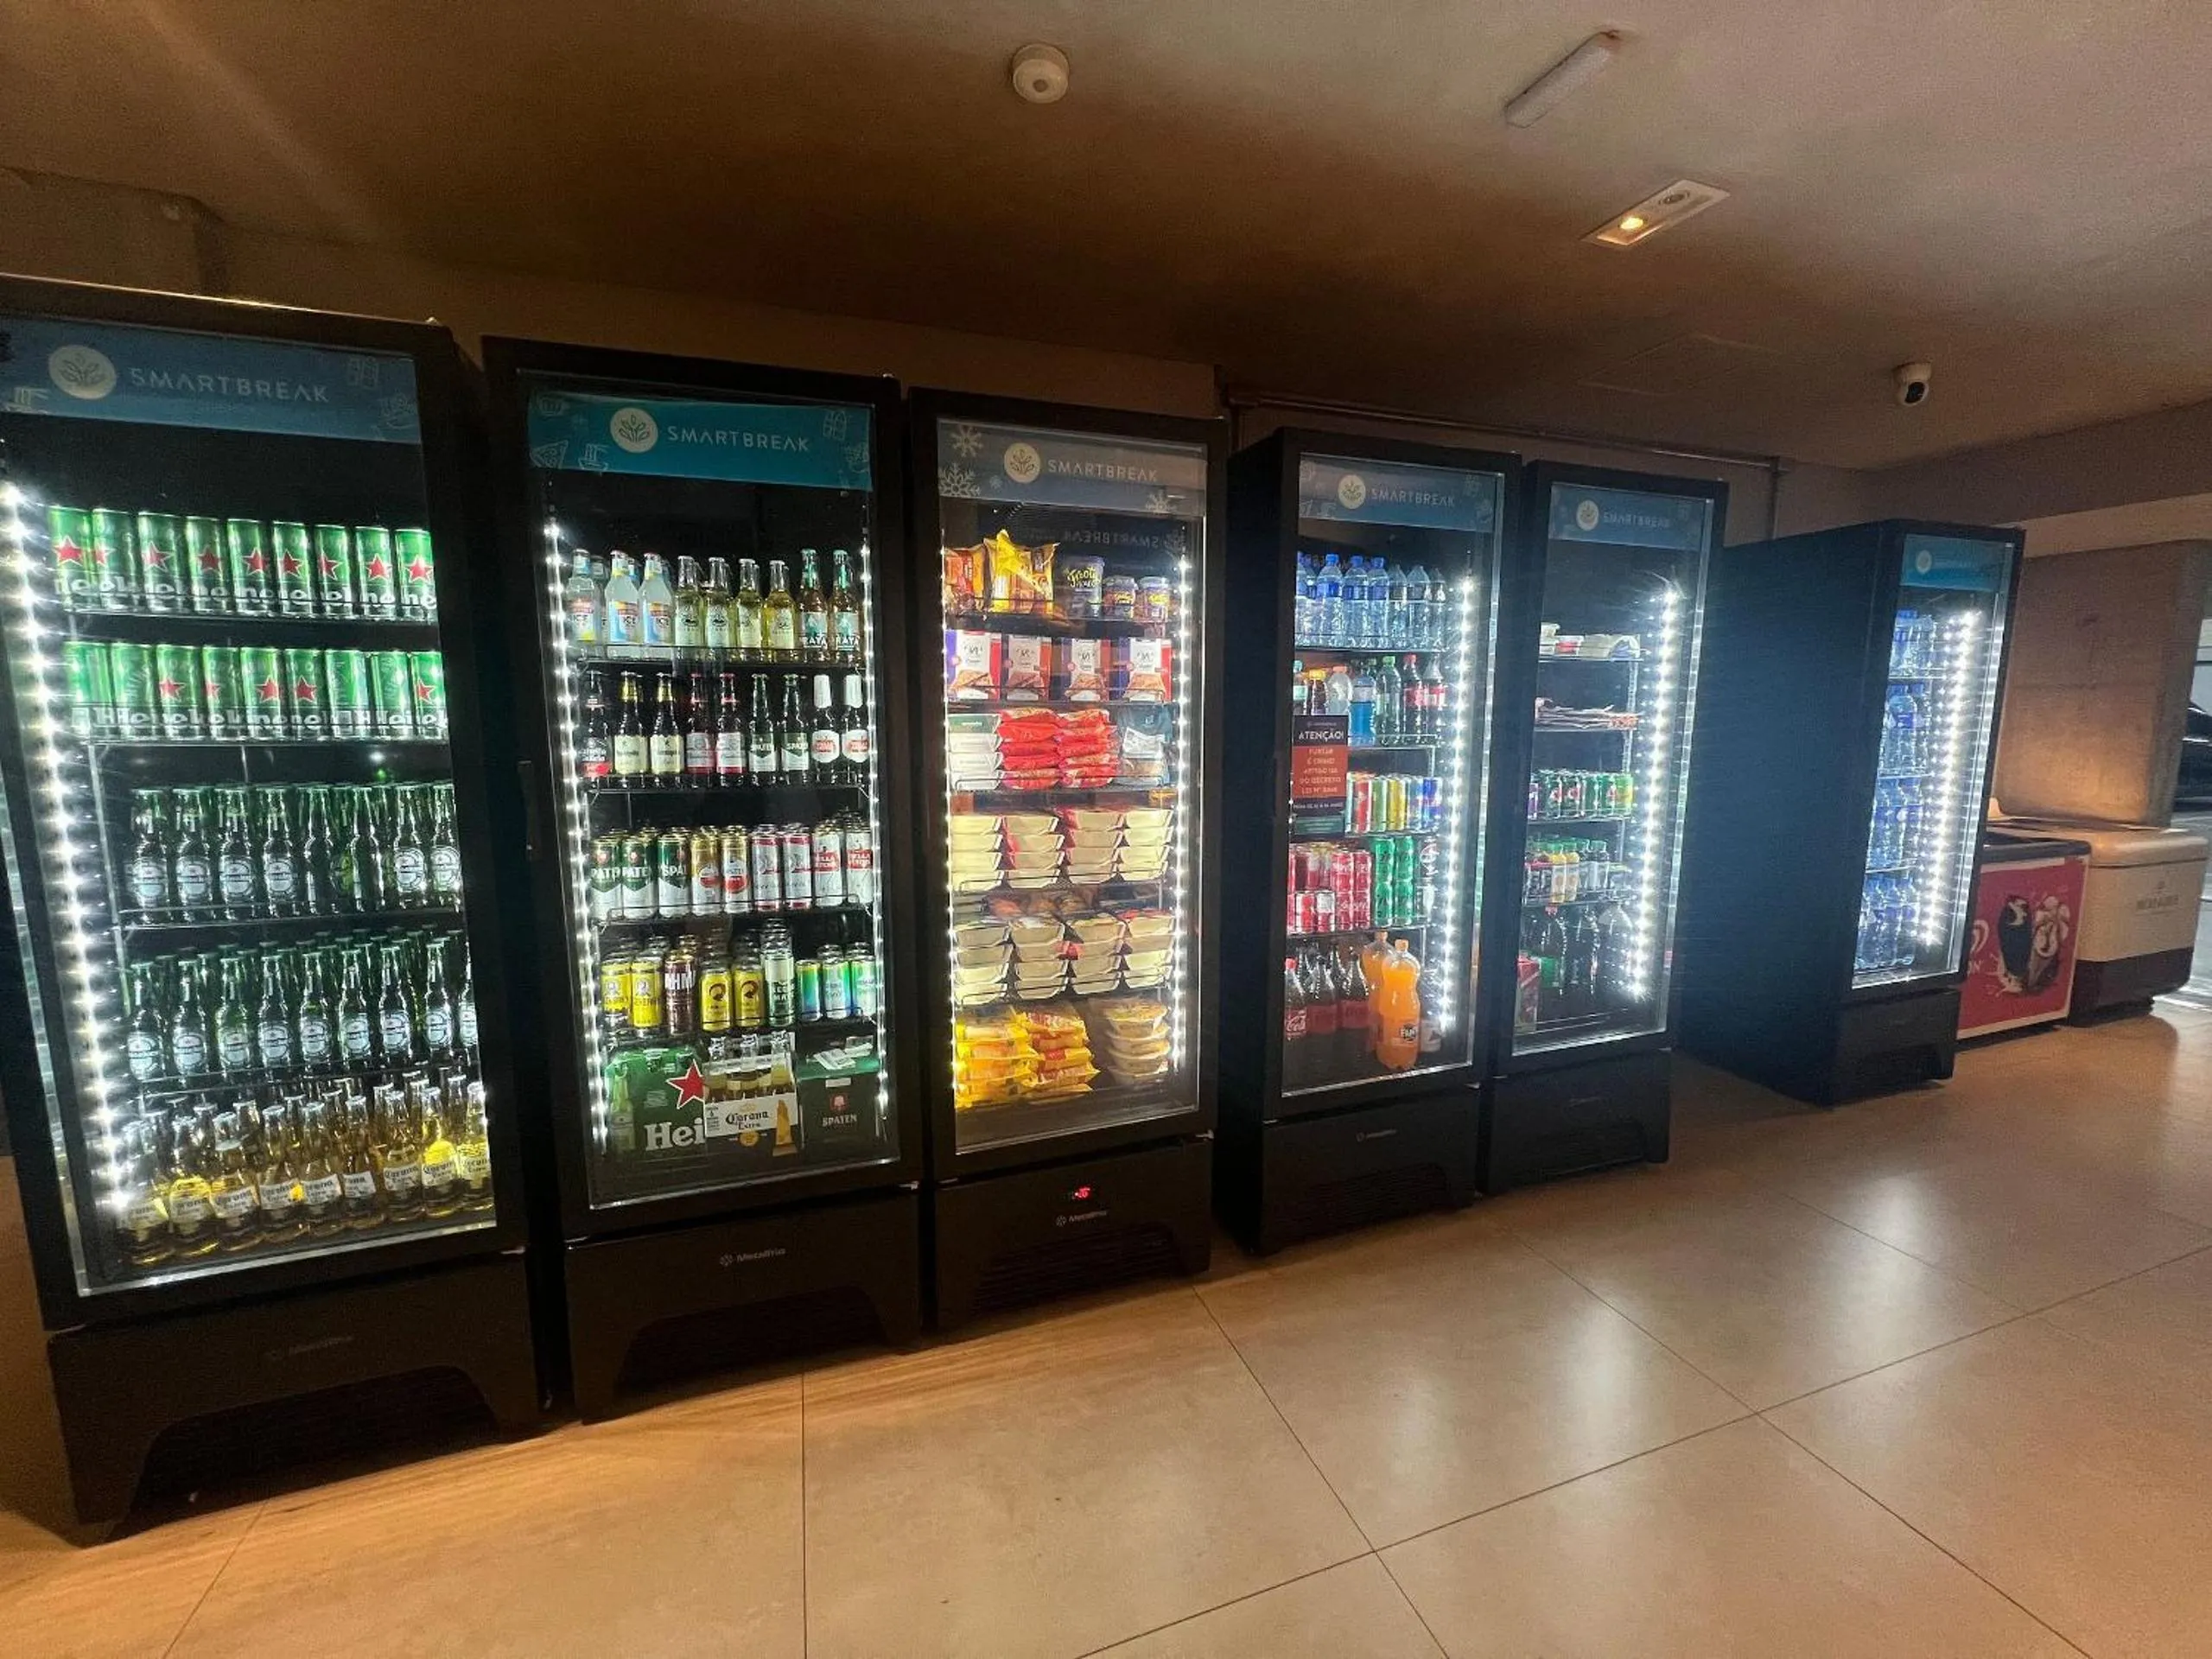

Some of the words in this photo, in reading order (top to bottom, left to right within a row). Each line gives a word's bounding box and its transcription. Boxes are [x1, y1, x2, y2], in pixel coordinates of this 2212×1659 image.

[129, 366, 331, 404] SMARTBREAK
[666, 424, 810, 453] SMARTBREAK
[1047, 458, 1159, 484] SMARTBREAK
[1370, 487, 1456, 509] SMARTBREAK
[1298, 728, 1344, 742] ATENÇÃO!
[725, 1110, 770, 1125] Corona
[822, 1114, 858, 1128] SPATEN
